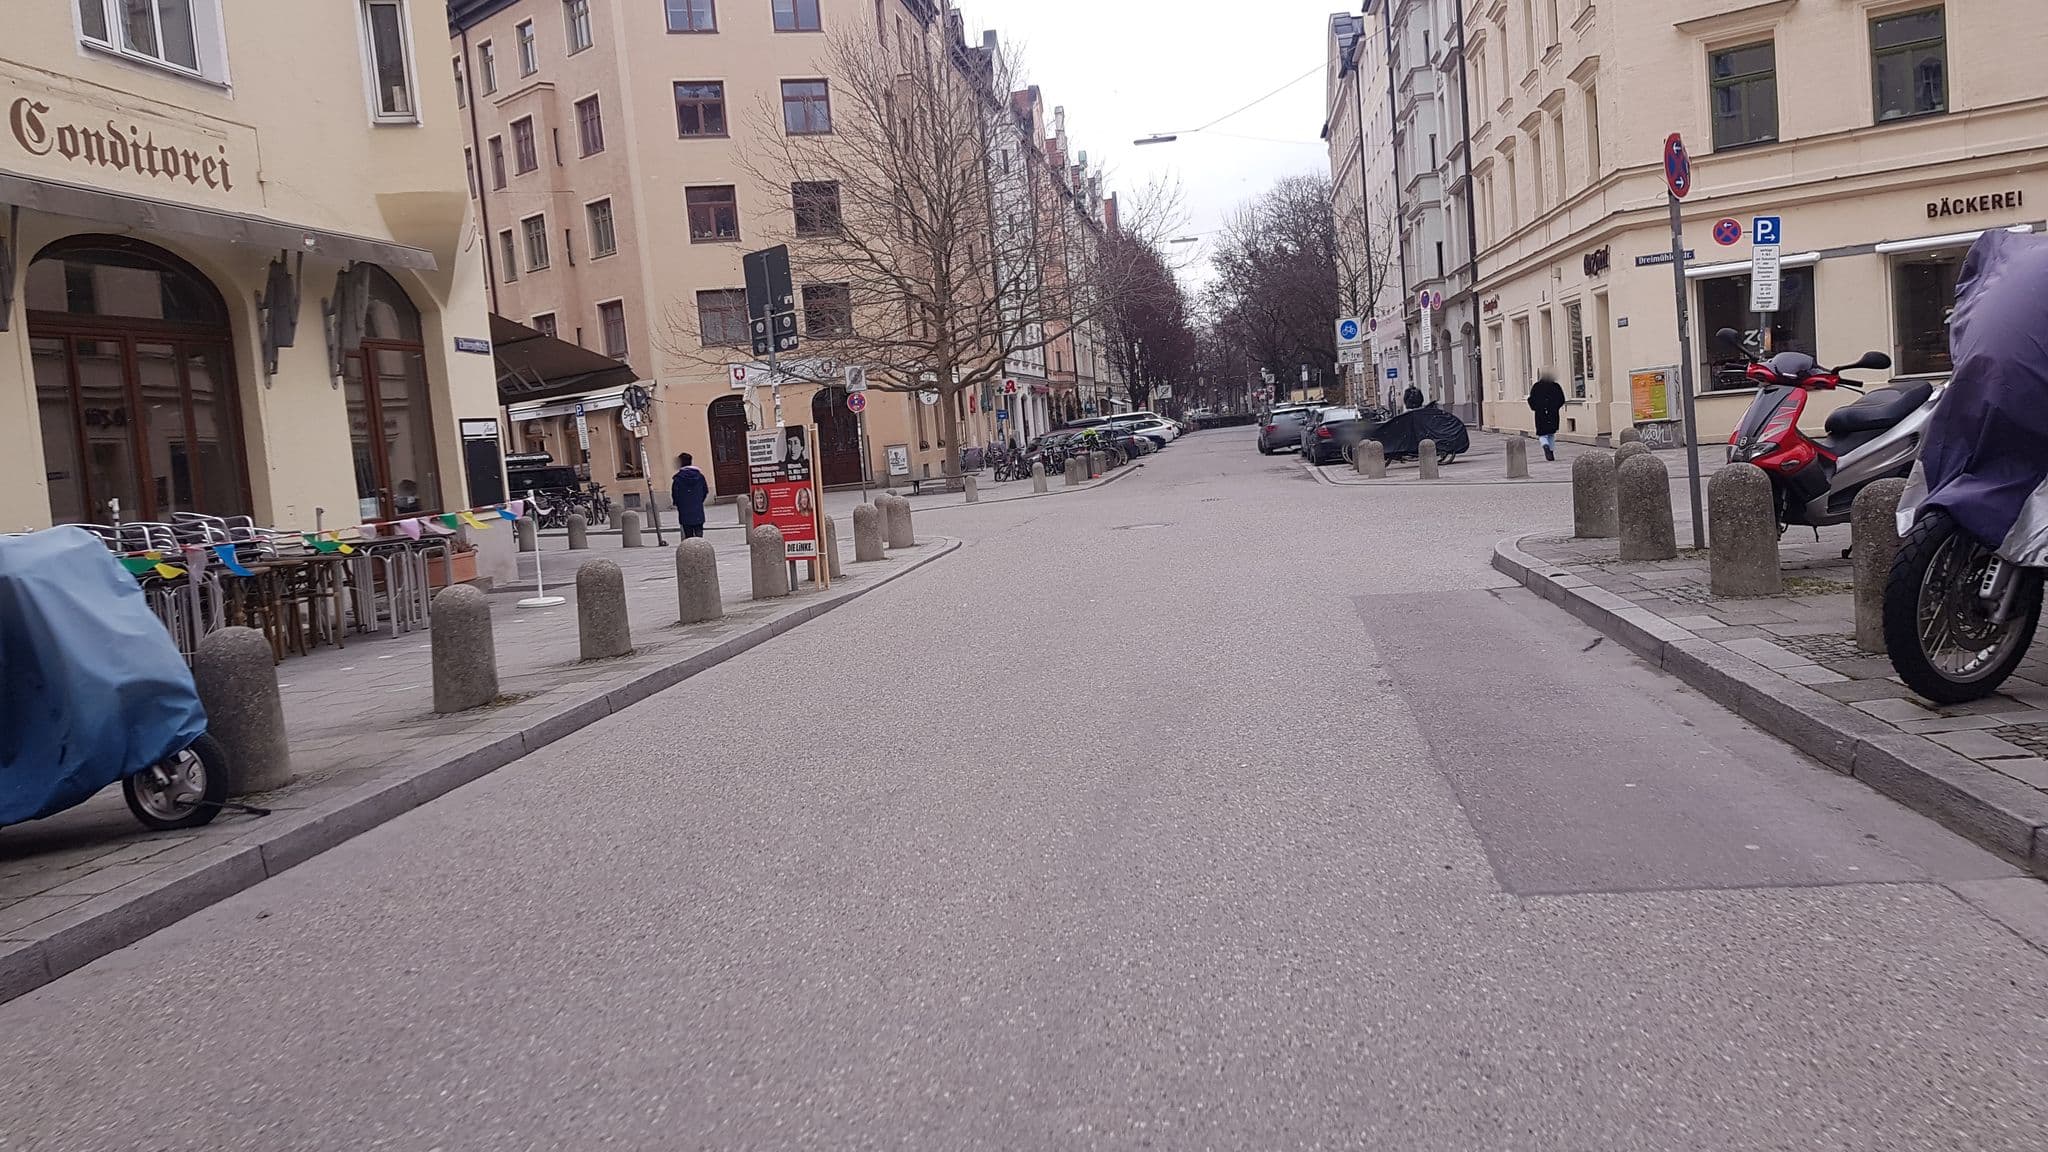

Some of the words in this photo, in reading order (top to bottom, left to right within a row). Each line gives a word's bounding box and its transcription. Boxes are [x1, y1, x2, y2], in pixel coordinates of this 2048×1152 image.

[10, 97, 234, 192] Conditorei
[1926, 190, 2023, 218] BÄCKEREI
[1757, 219, 1773, 242] P
[787, 543, 796, 552] DIE
